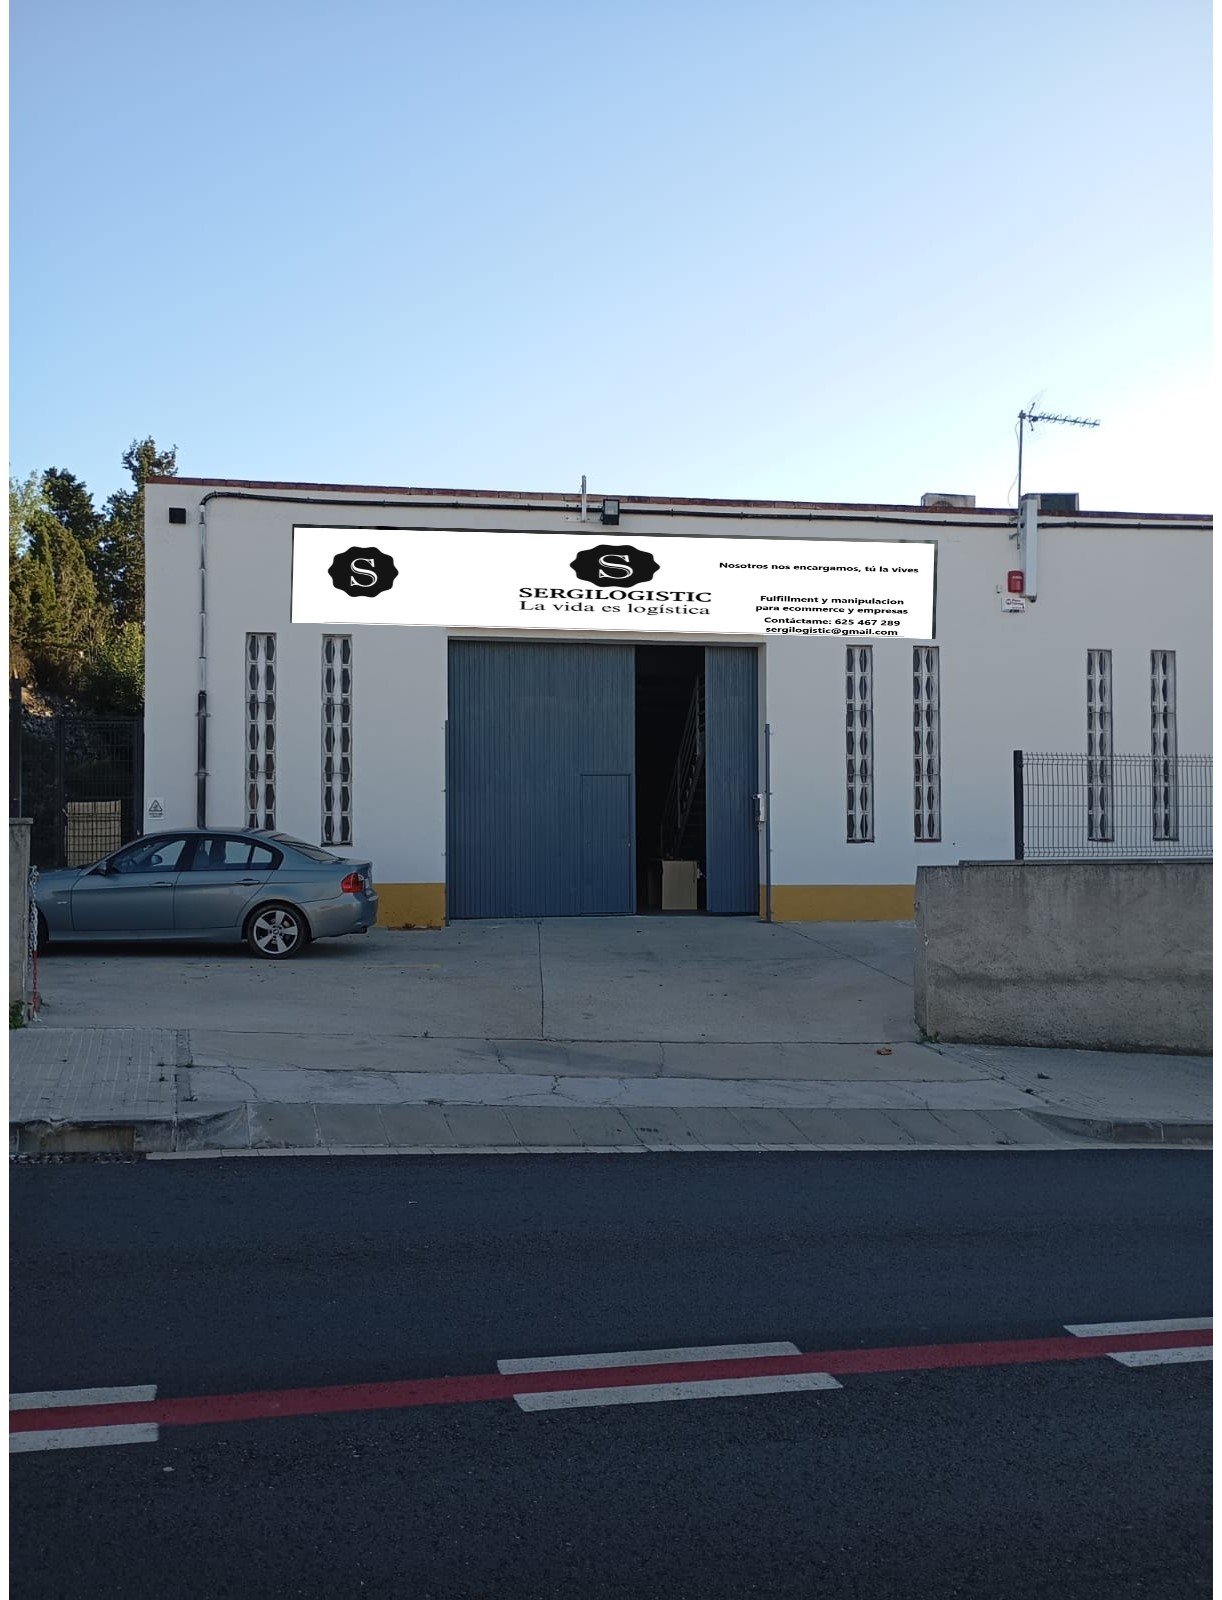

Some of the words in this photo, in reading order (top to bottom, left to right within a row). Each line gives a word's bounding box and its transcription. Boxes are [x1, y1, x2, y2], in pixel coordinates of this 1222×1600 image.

[598, 554, 634, 579] S
[719, 562, 769, 570] Nosotros
[771, 563, 791, 571] nos
[793, 563, 862, 573] encargamos,
[865, 564, 876, 572] tú
[879, 565, 889, 573] la
[892, 565, 919, 573] vives
[350, 557, 378, 588] S
[519, 587, 712, 603] SERGILOGISTIC
[760, 595, 819, 603] Fulfillment
[520, 600, 546, 611] La
[554, 601, 595, 612] vida
[602, 605, 621, 613] es
[628, 603, 711, 616] logística
[847, 607, 854, 615] y
[857, 607, 908, 615] empresas
[764, 617, 832, 625] Contáctame:
[834, 618, 854, 626] 625
[765, 626, 898, 636] sergilogistic@gmail.com
